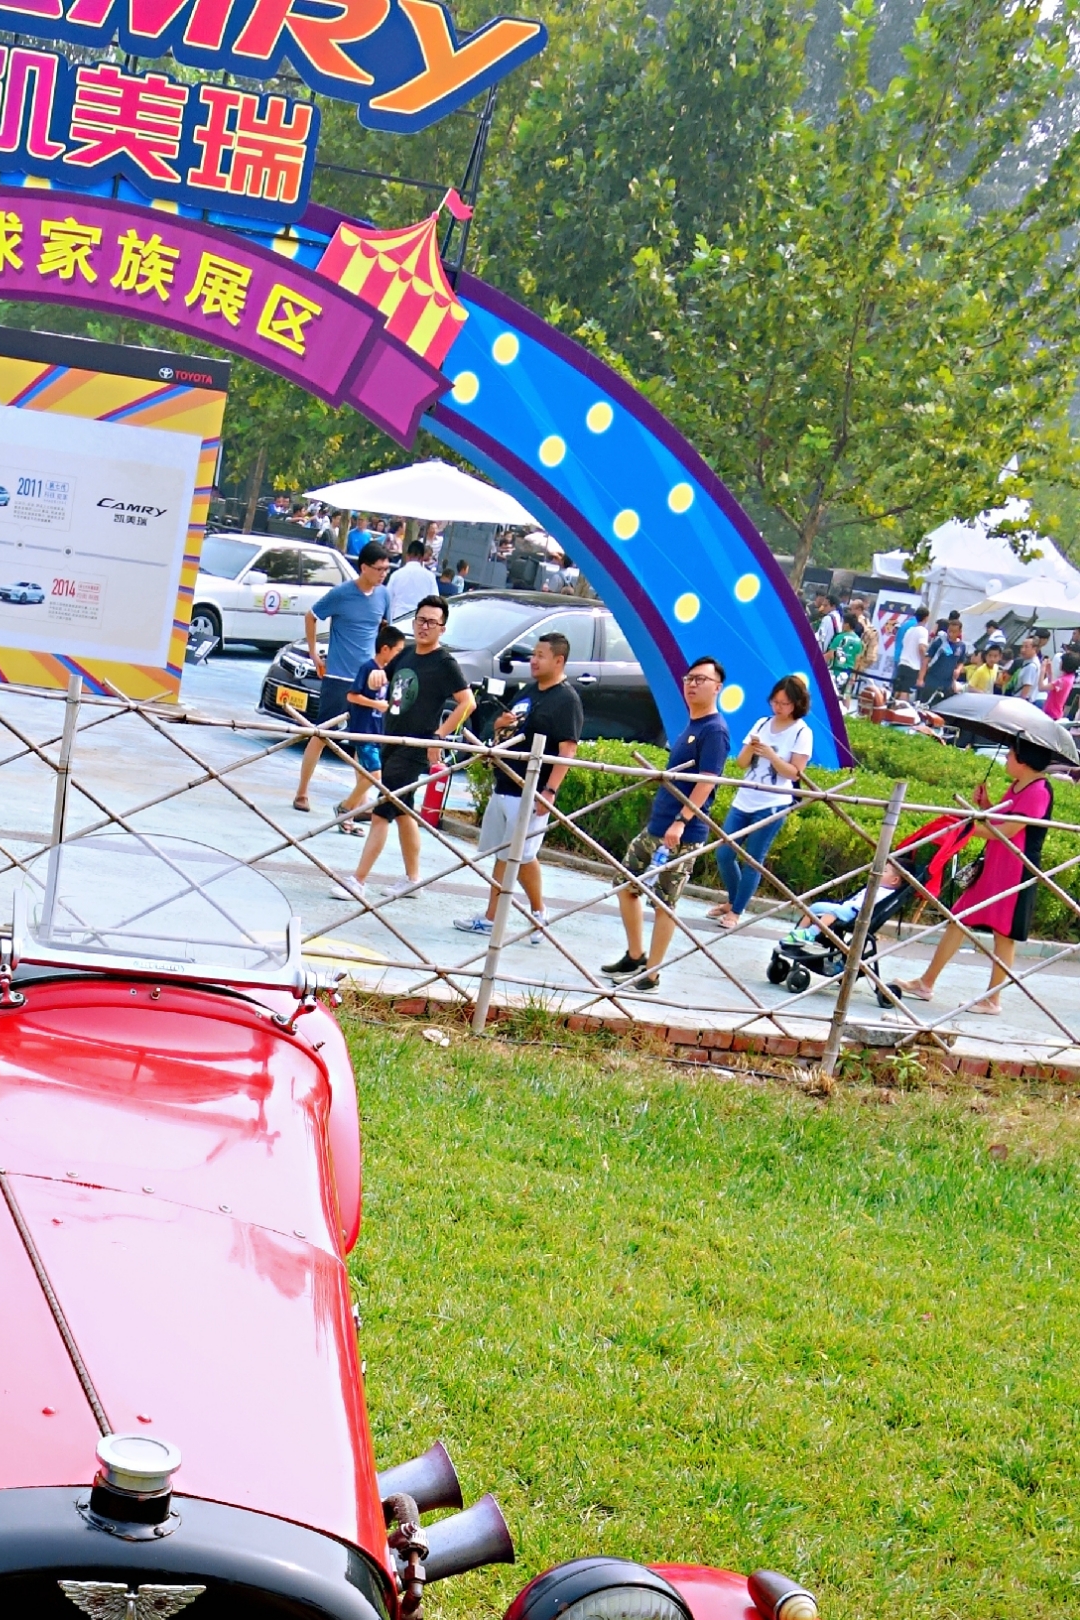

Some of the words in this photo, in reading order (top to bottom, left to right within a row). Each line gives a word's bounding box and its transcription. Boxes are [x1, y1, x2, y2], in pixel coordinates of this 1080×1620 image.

[175, 370, 213, 385] TOYOTA
[16, 477, 43, 498] 2011
[96, 498, 168, 517] CAMRY
[114, 513, 148, 526] 凯美瑞
[51, 578, 76, 598] 2014
[267, 595, 276, 608] 2
